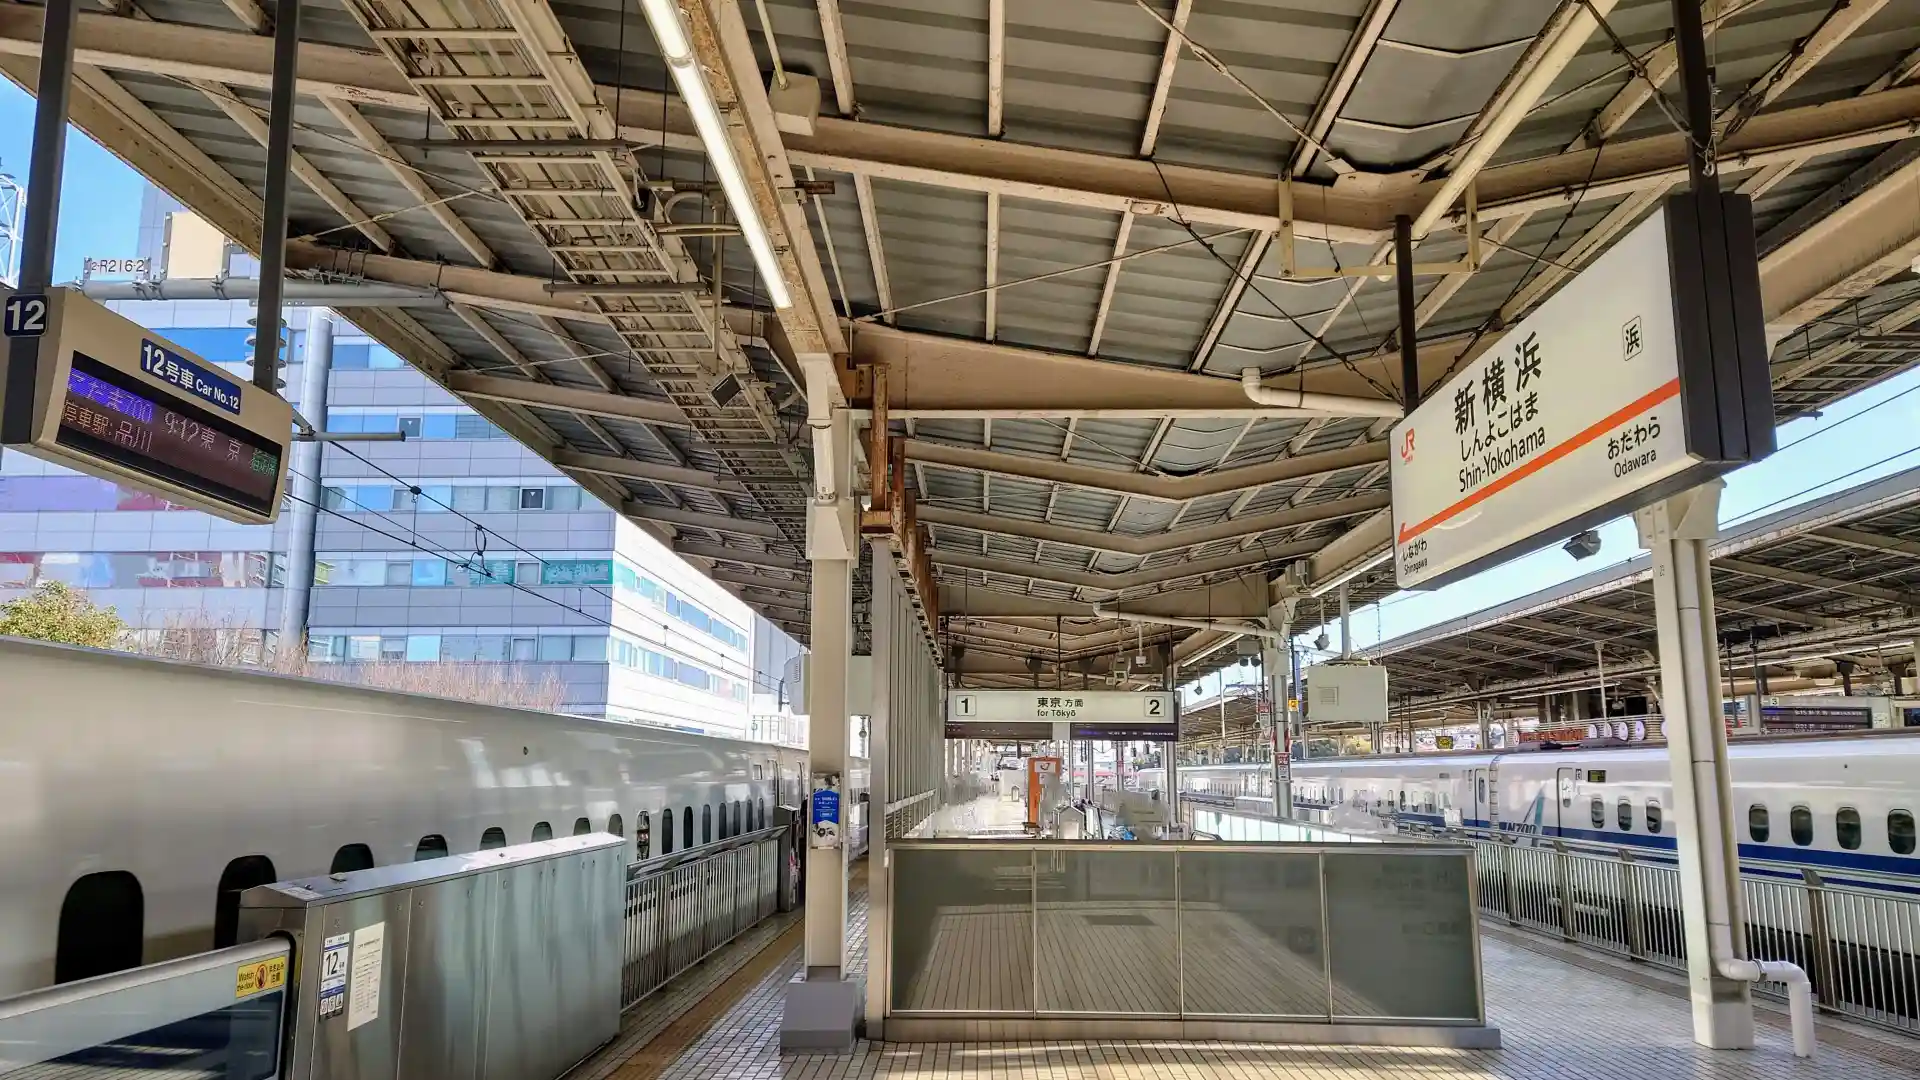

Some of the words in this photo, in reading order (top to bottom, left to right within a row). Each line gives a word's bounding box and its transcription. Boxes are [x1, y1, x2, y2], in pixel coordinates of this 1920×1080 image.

[7, 300, 46, 331] 12
[1625, 323, 1640, 355] 浜
[143, 344, 195, 389] 12号車
[196, 378, 212, 396] Car
[1454, 331, 1542, 435] 新横浜
[1460, 391, 1539, 462] しんよこはま
[1607, 416, 1661, 460] おだわら
[1401, 428, 1415, 458] JR
[1459, 426, 1546, 493] Shin-Yokohama
[1614, 448, 1657, 478] Odawara
[1402, 538, 1428, 562] しながわ
[1404, 557, 1428, 576] Shinagawa
[960, 697, 970, 714] 1
[1036, 696, 1061, 708] 東京
[1037, 709, 1049, 717] for
[1148, 698, 1161, 715] 2
[325, 951, 339, 977] 12
